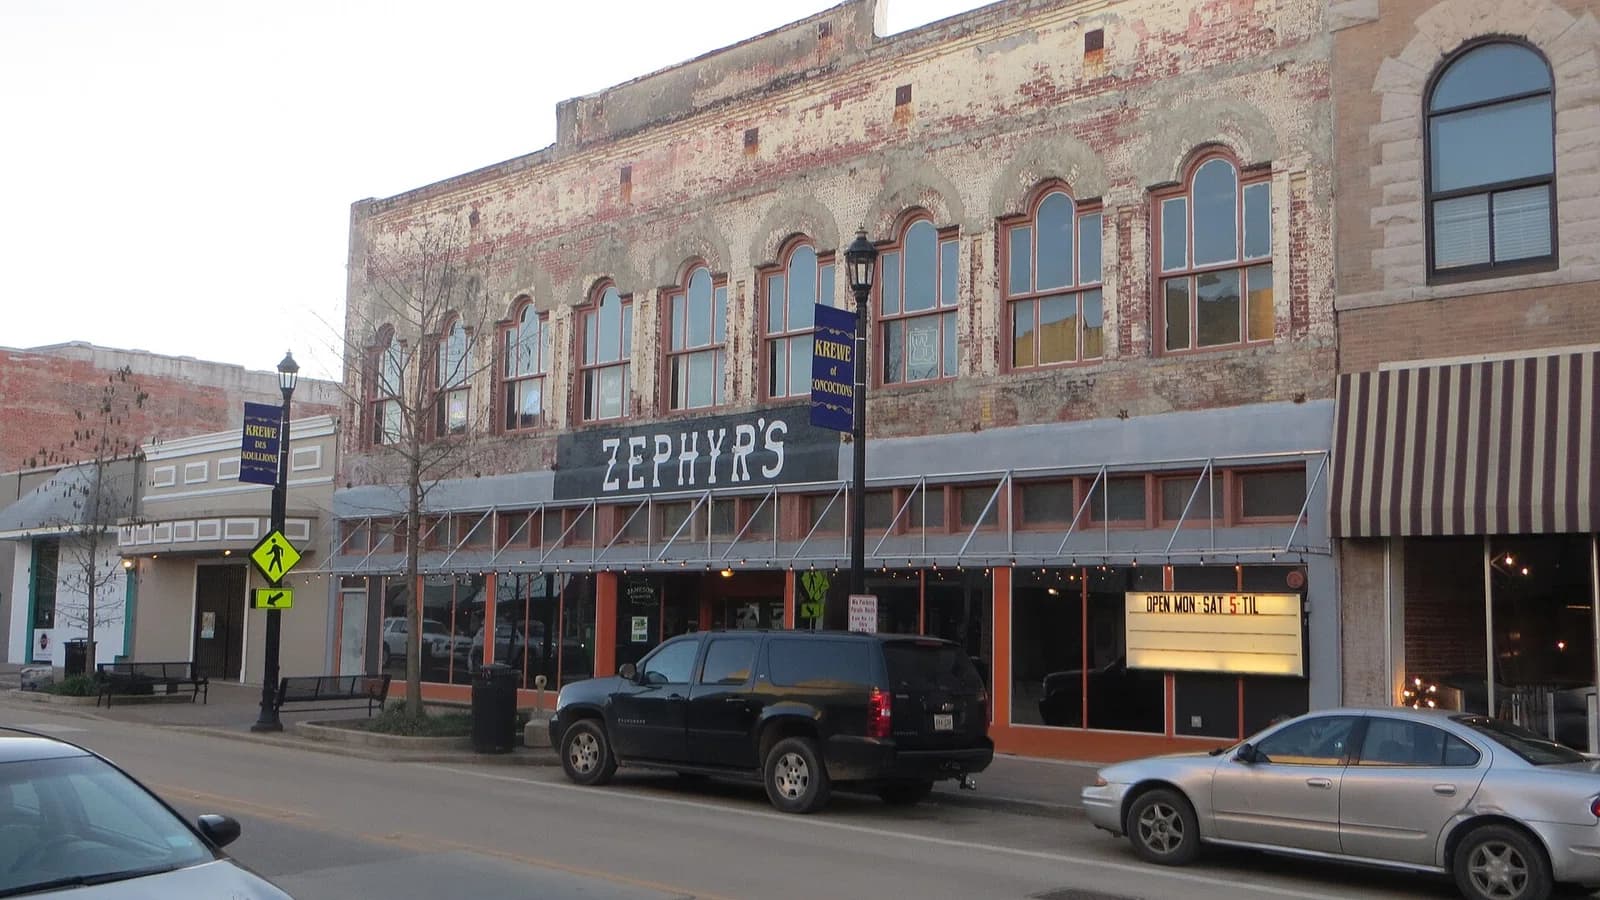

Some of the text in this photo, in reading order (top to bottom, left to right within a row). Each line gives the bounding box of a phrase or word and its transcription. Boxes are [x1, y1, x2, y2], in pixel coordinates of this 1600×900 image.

[815, 339, 851, 362] KREWE
[246, 424, 277, 439] KREWE
[602, 417, 787, 492] ZEPHYR'S
[1146, 595, 1170, 613] OPEN
